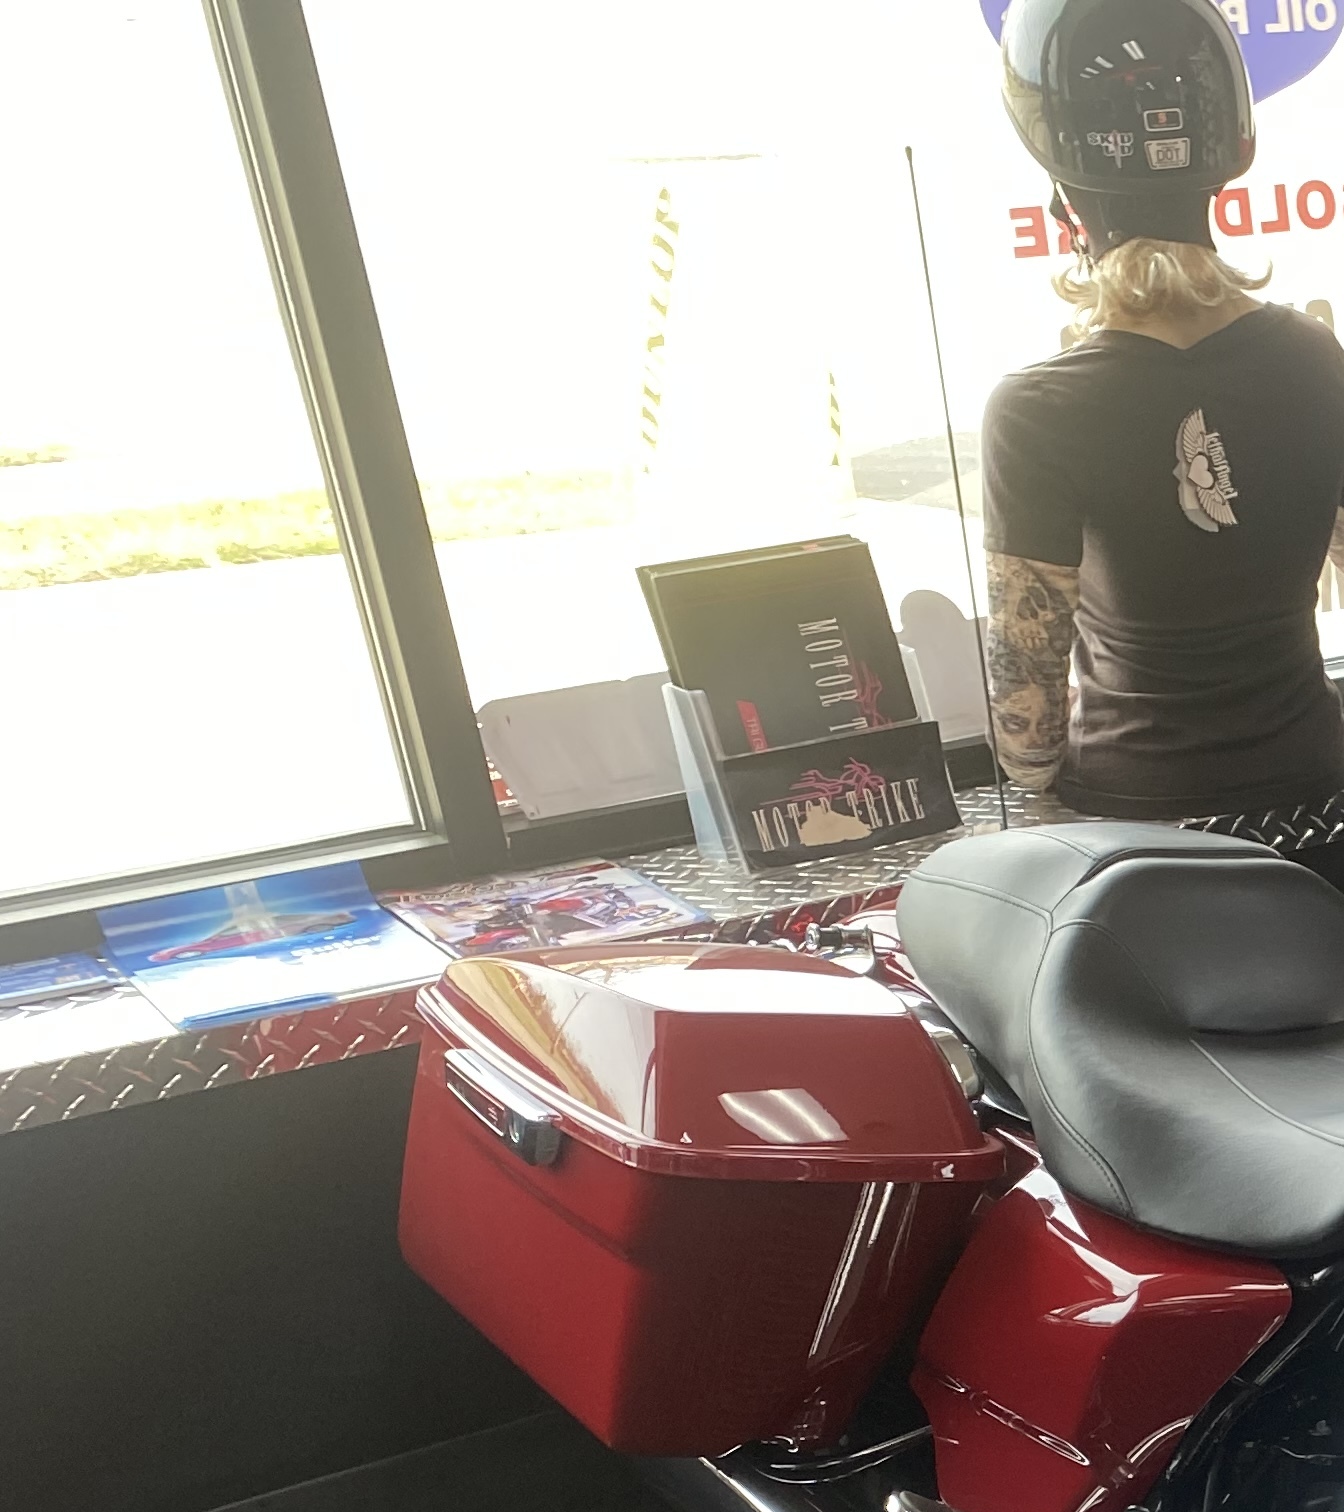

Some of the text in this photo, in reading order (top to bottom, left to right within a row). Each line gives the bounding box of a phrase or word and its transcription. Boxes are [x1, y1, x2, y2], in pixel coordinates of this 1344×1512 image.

[1156, 147, 1181, 161] DOT
[797, 617, 858, 708] MOTOR
[845, 777, 926, 830] TRIKE
